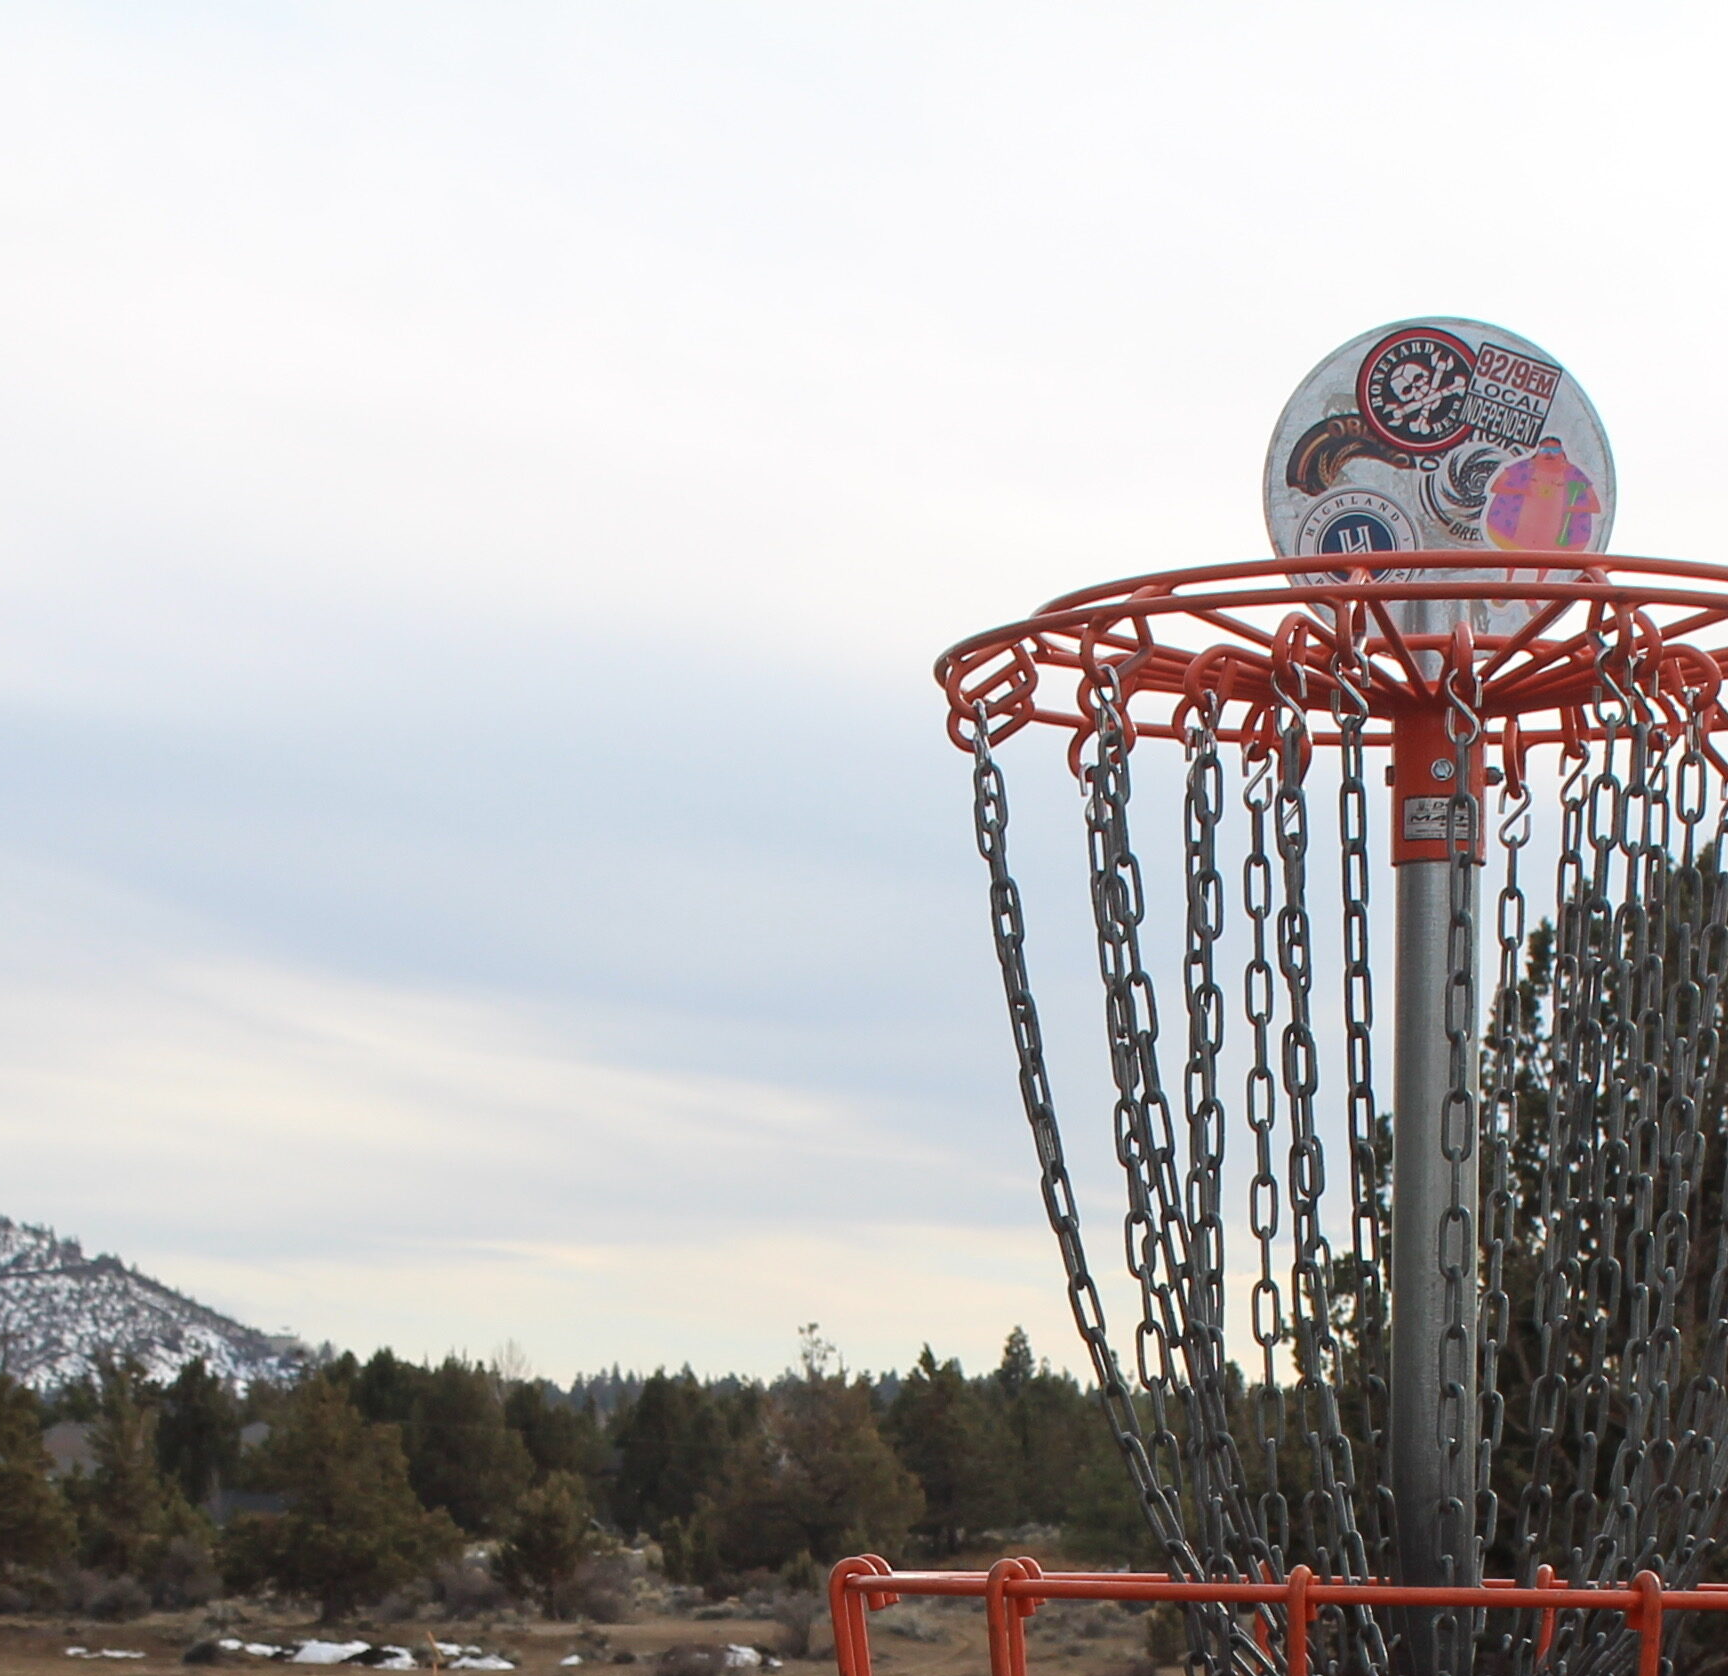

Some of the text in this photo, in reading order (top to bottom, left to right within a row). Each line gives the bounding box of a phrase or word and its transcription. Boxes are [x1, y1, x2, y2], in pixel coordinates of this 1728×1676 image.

[1370, 341, 1435, 408] BONEYARD
[1432, 400, 1463, 434] BEER
[1470, 377, 1544, 416] LOCAL
[1458, 394, 1543, 446] INDEPENDENT
[1305, 496, 1400, 537] HIGHLAND
